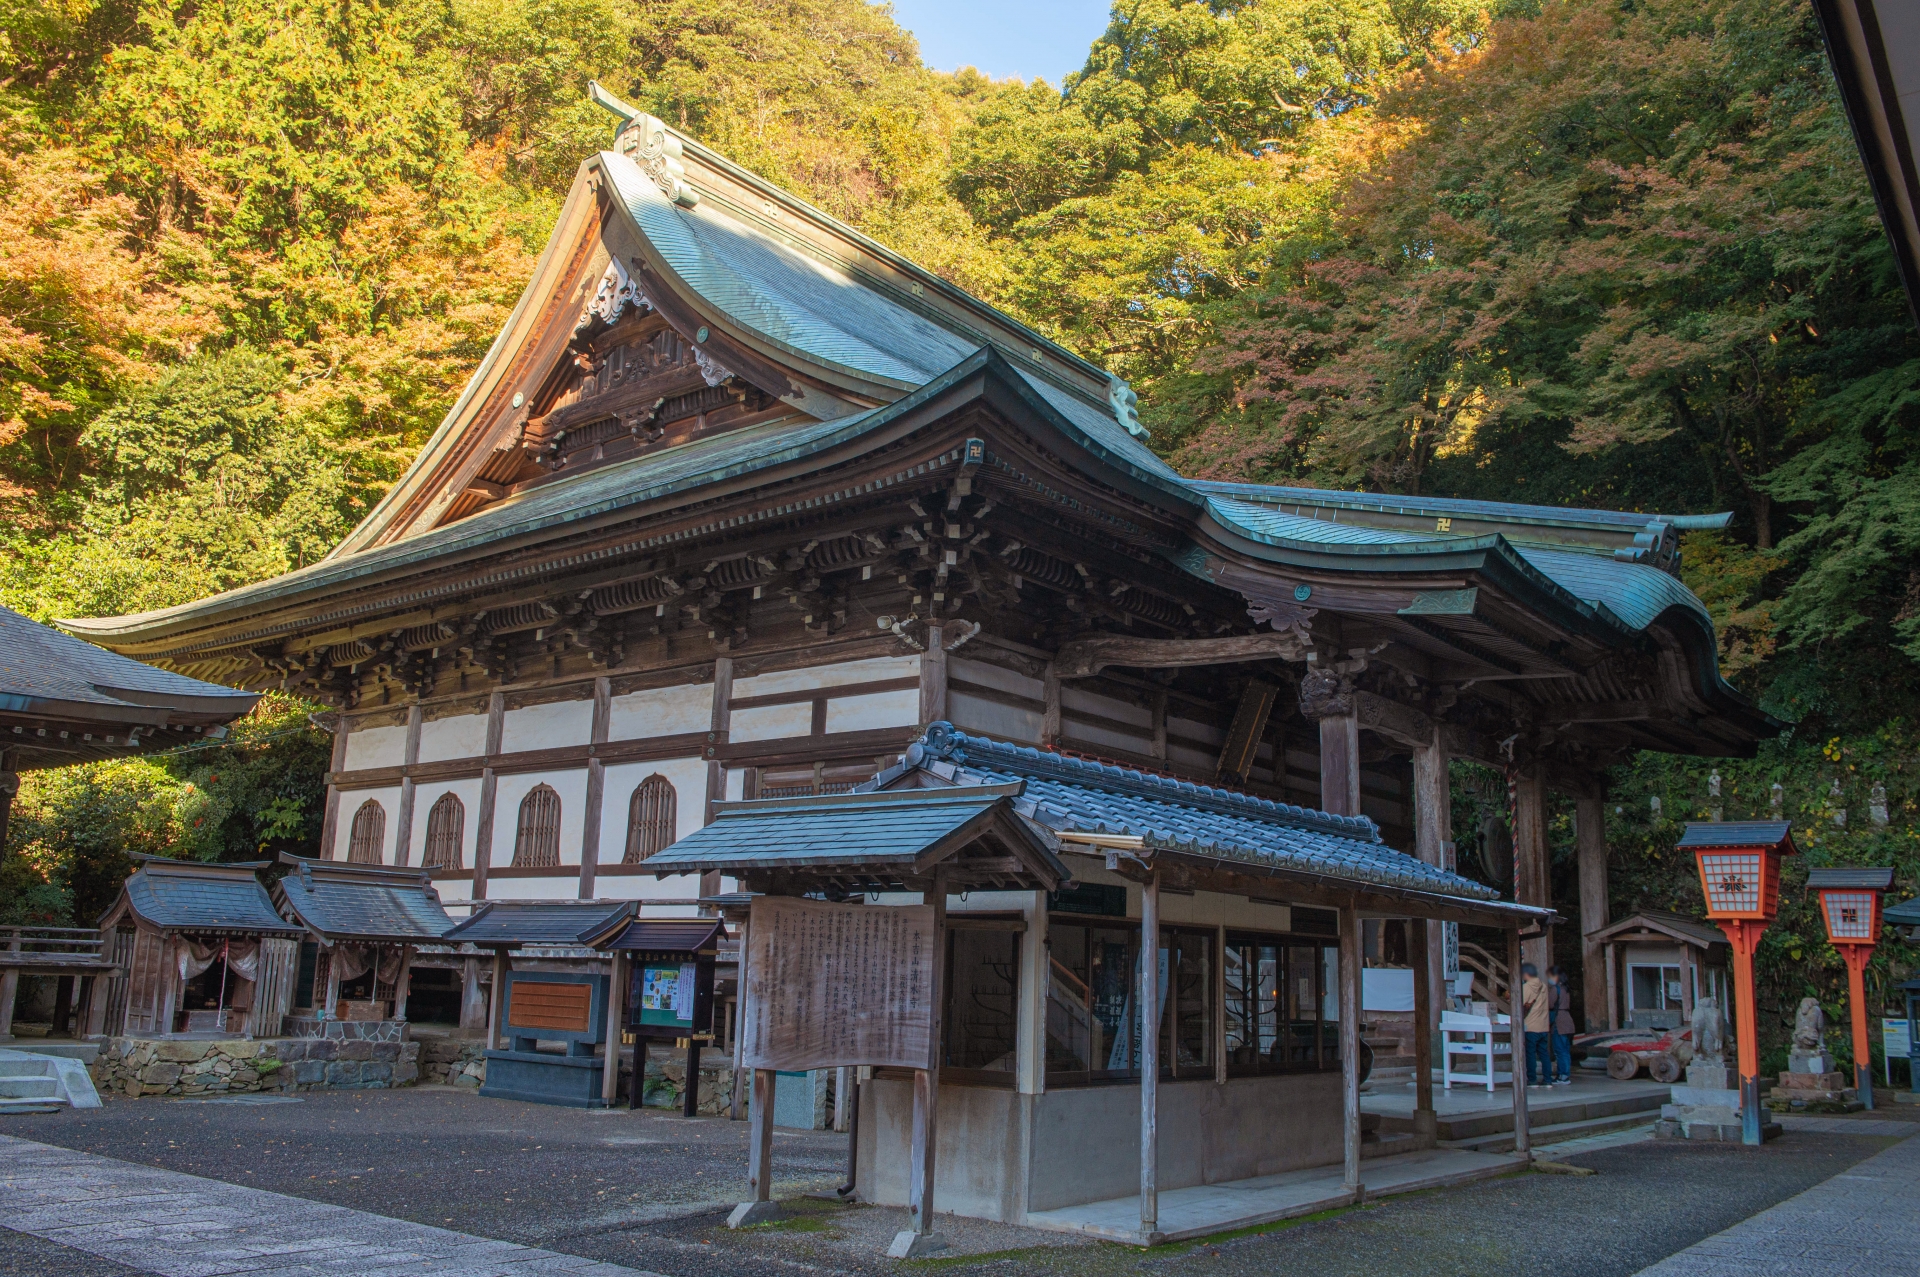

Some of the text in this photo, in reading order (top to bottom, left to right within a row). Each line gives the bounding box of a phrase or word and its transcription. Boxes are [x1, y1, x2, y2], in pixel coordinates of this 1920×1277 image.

[909, 929, 921, 1009] 本吉山清水寺
